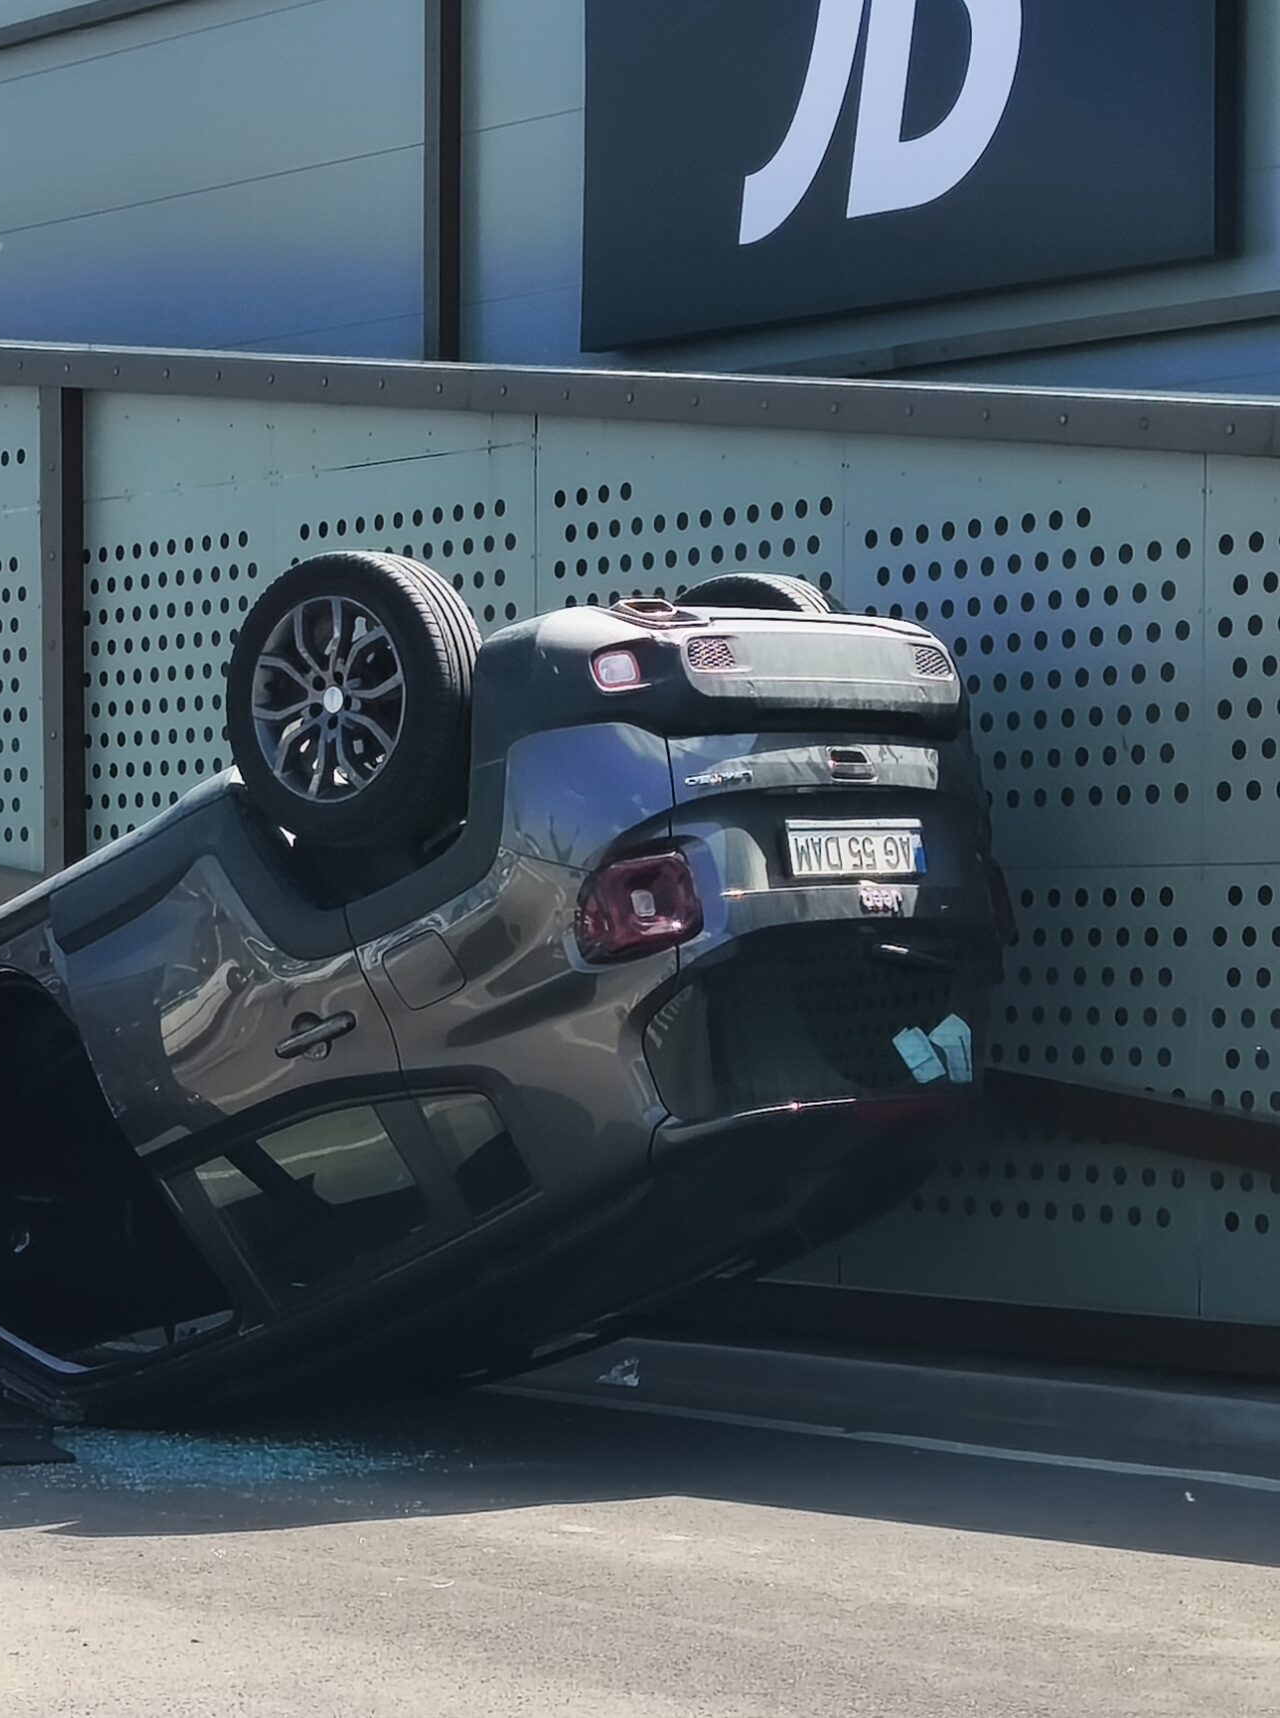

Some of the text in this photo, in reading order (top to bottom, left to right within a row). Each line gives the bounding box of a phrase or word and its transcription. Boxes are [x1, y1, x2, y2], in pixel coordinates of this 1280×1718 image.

[739, 0, 1022, 246] JD
[794, 836, 910, 872] AG 55 DAM
[859, 886, 903, 913] Jeep
